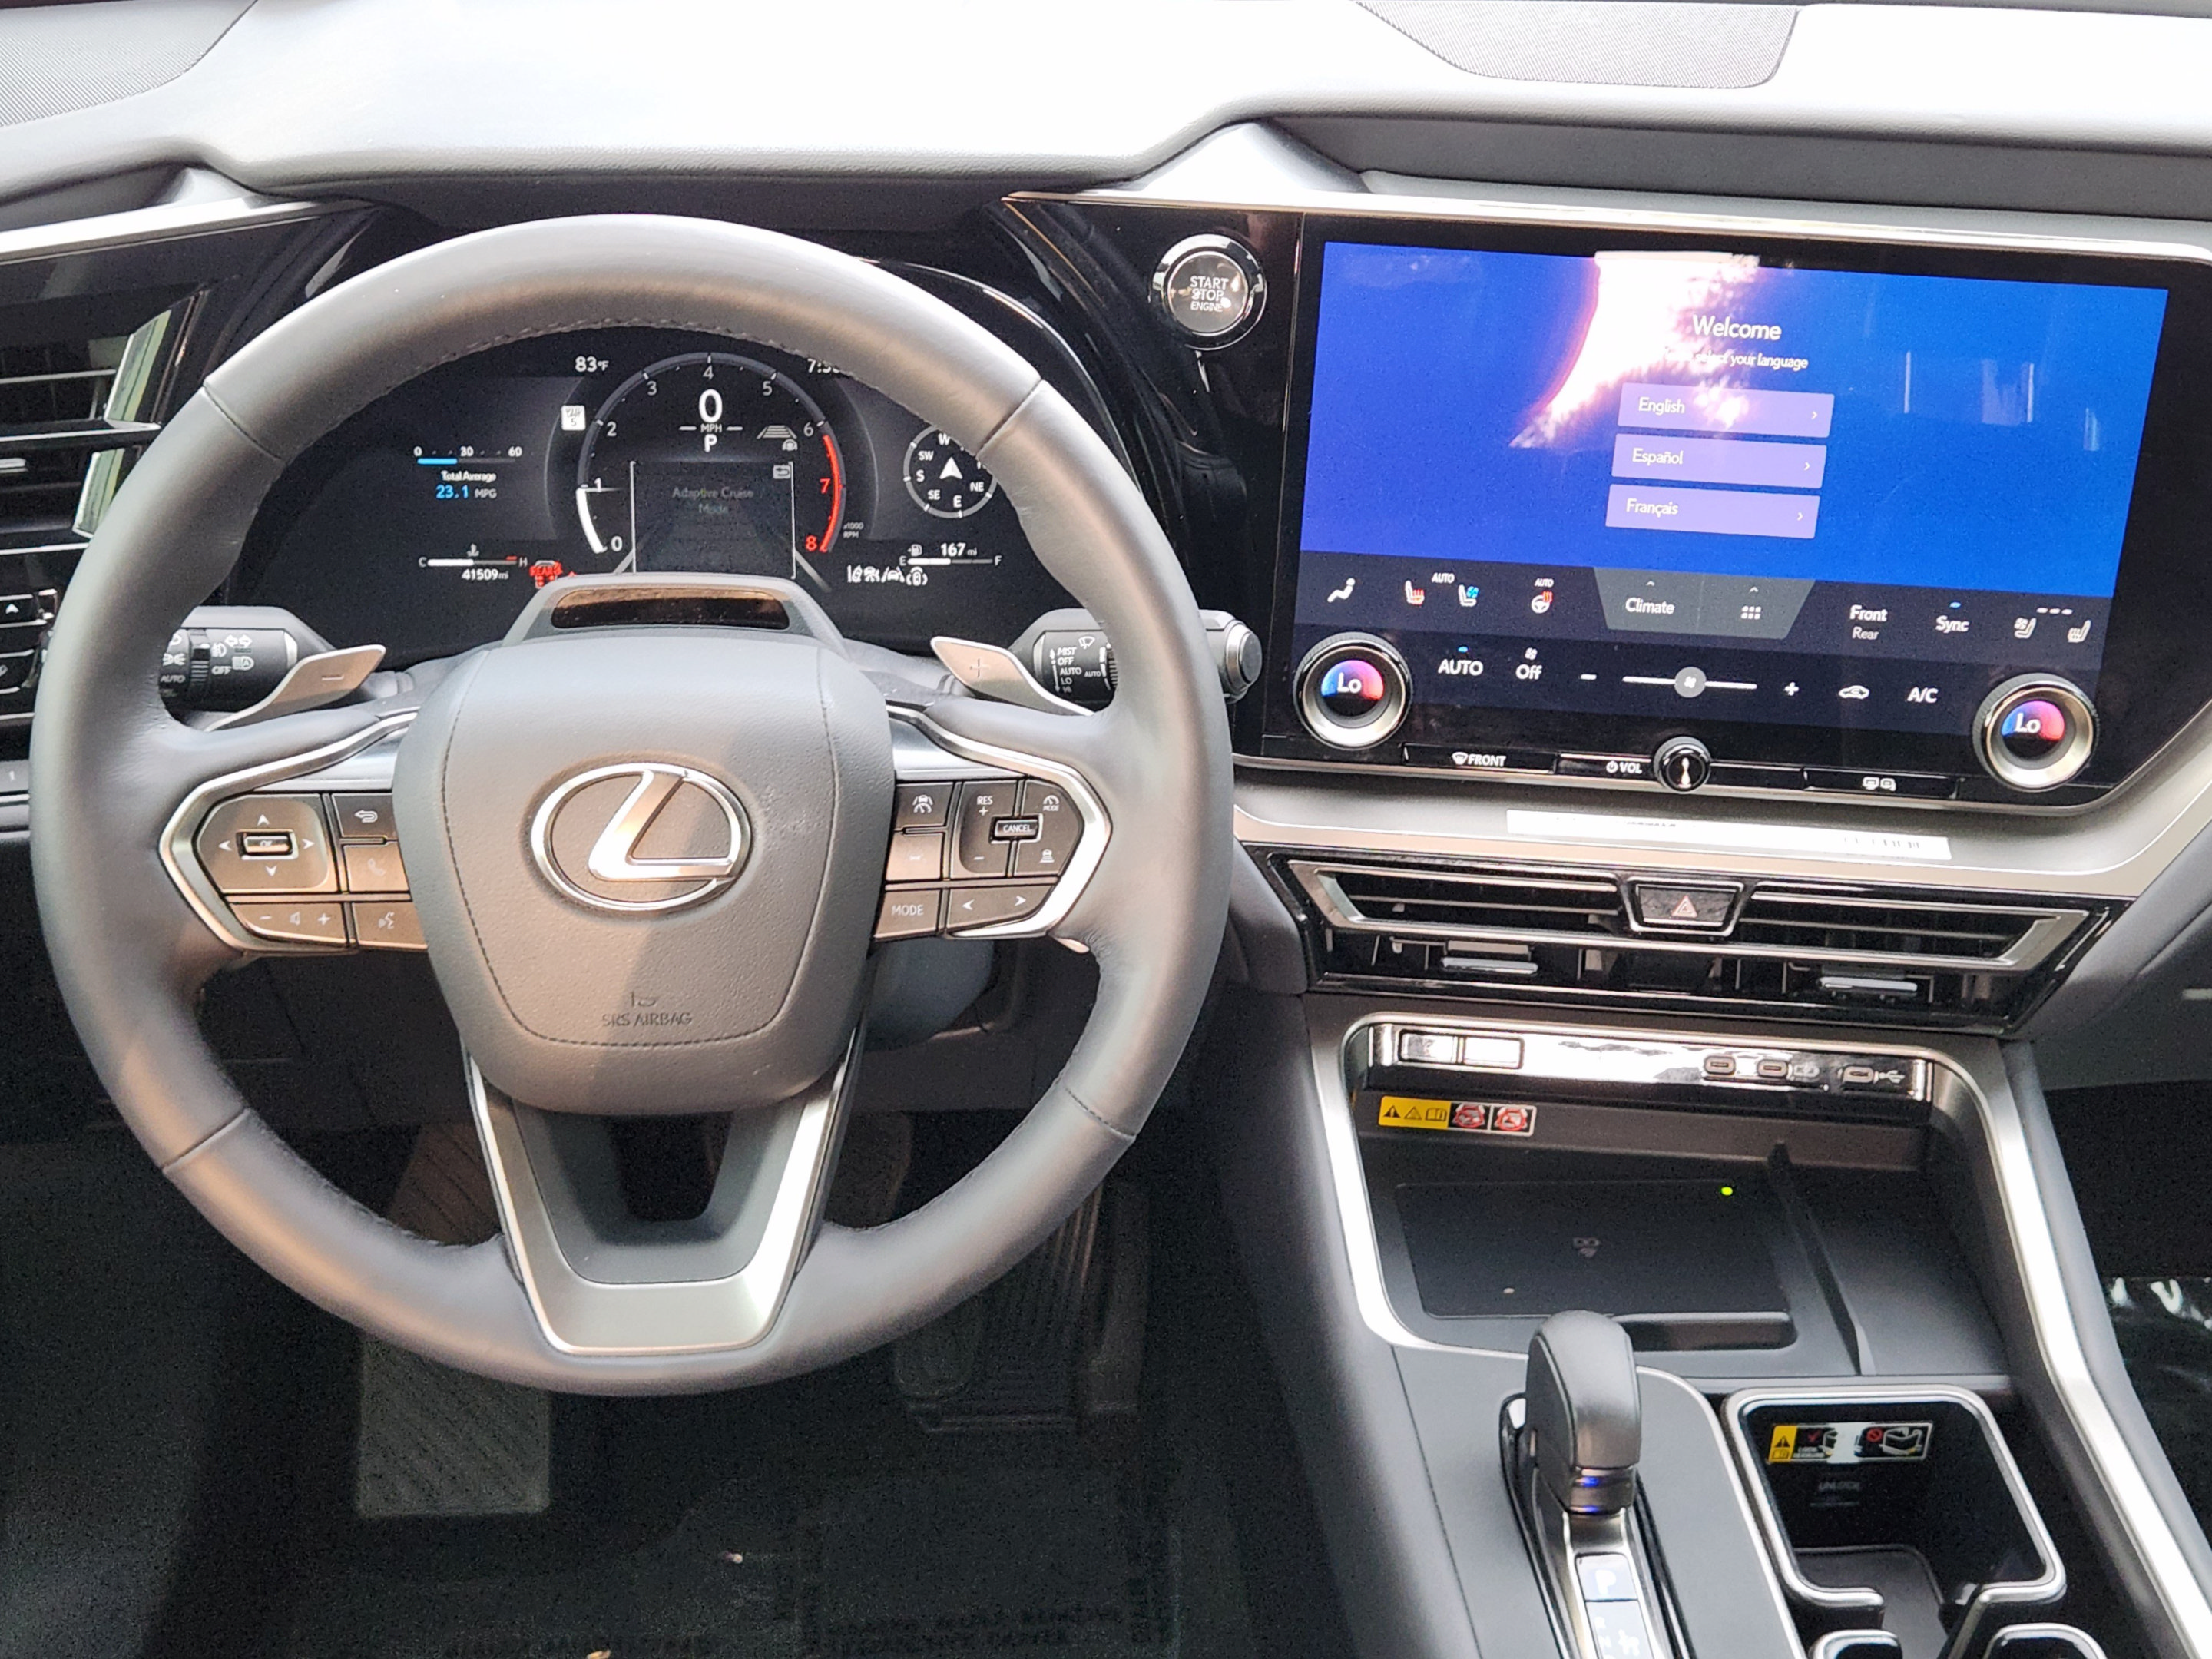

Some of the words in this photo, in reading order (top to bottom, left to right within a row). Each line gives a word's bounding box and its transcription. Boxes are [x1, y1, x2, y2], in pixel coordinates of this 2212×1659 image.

[1190, 275, 1229, 290] START
[1191, 301, 1224, 312] ENGINE
[1692, 314, 1782, 340] Welcome
[1729, 354, 1756, 367] your
[1757, 353, 1809, 371] language
[702, 366, 714, 379] 4
[647, 382, 657, 395] 3
[763, 382, 773, 396] 5
[698, 389, 723, 422] 0
[1638, 397, 1685, 416] English
[607, 422, 617, 436] 2
[700, 423, 722, 432] MPH
[803, 423, 814, 436] 6
[704, 434, 717, 452] P
[938, 433, 951, 445] W
[413, 446, 422, 456] 0
[460, 446, 474, 456] 30
[508, 446, 522, 456] 60
[919, 450, 934, 461] SW
[1632, 448, 1684, 465] Español
[441, 470, 462, 482] Total
[462, 472, 497, 483] Average
[916, 470, 925, 482] S
[594, 478, 602, 492] 1
[820, 478, 830, 493] 7
[970, 482, 985, 492] NE
[436, 485, 469, 499] 23.1
[475, 488, 497, 498] MPG
[928, 489, 941, 500] SE
[953, 495, 962, 508] E
[1626, 498, 1678, 518] Français
[611, 536, 622, 551] 0
[805, 537, 817, 551] 8
[941, 543, 965, 555] 167
[419, 558, 427, 567] C
[519, 558, 528, 567] H
[899, 556, 906, 565] E
[995, 556, 1002, 565] F
[1432, 573, 1455, 584] AUTO
[1535, 578, 1554, 587] AUTO
[1625, 597, 1675, 615] Climate
[1849, 604, 1888, 622] Front
[1936, 615, 1969, 633] Sync
[1852, 626, 1879, 641] Rear
[1057, 647, 1077, 656] MIST
[1058, 657, 1075, 666] OFF
[1438, 659, 1483, 676] AUTO
[211, 666, 231, 674] OFF
[1060, 667, 1082, 676] AUTO
[1515, 664, 1542, 680] Off
[160, 674, 186, 683] AUTO
[1061, 677, 1073, 685] LO
[1337, 671, 1362, 694] Lo
[1907, 686, 1939, 703] A/C
[2015, 712, 2041, 734] Lo
[1468, 753, 1506, 767] FRONT
[1619, 761, 1642, 774] VOL
[977, 796, 993, 805] RES
[1003, 823, 1032, 833] CANCEL
[892, 904, 924, 916] MODE
[602, 1012, 631, 1027] SRS
[633, 1012, 693, 1027] AIRBAG
